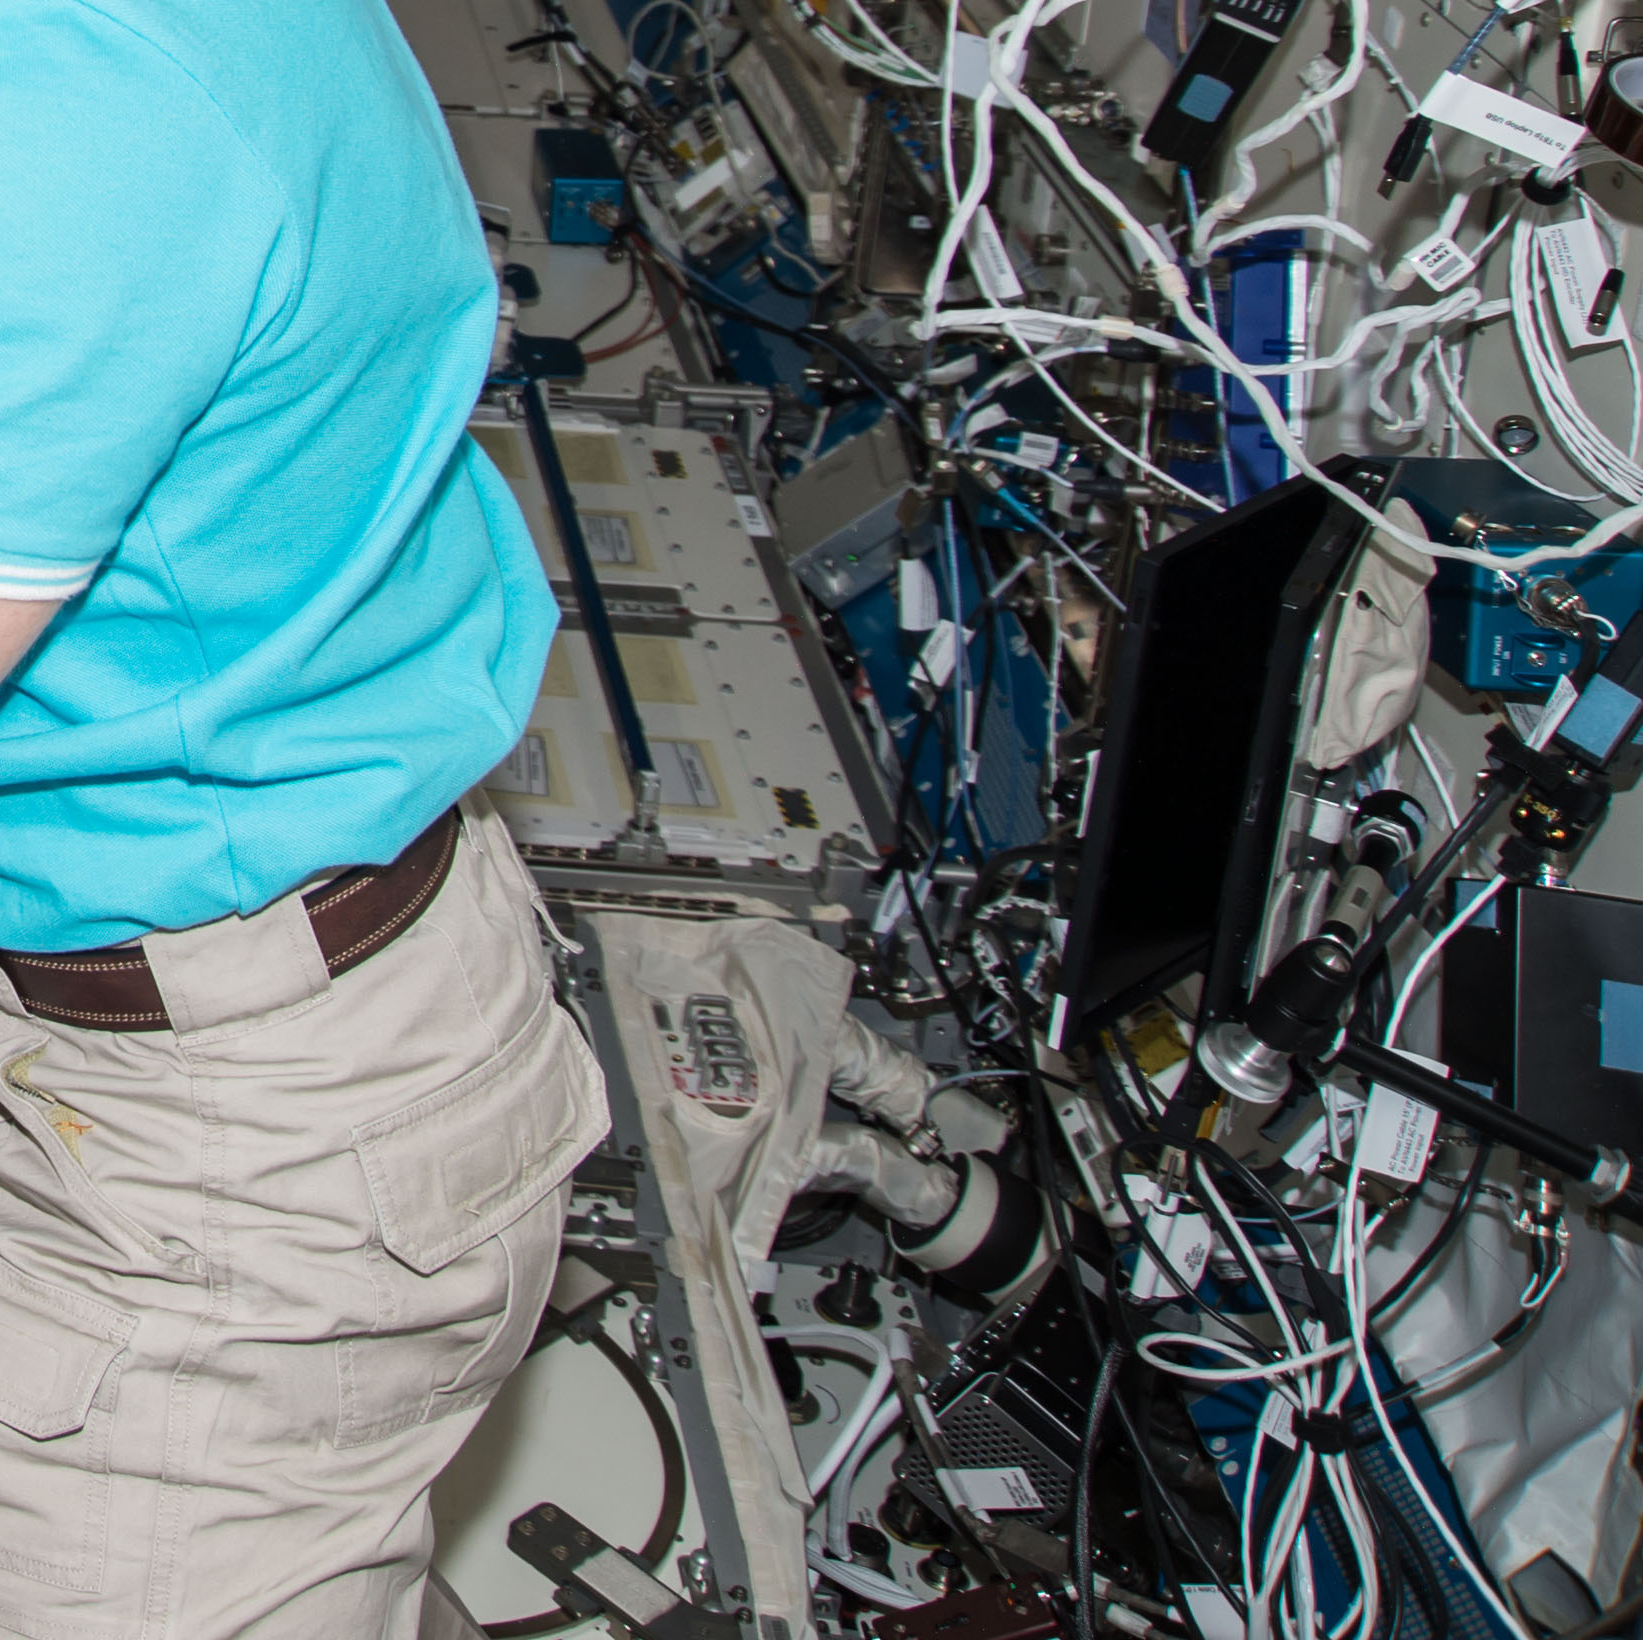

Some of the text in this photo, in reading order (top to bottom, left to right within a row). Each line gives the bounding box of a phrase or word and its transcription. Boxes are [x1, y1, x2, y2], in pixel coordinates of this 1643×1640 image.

[1485, 111, 1504, 125] USB
[1504, 118, 1534, 137] Laptop
[1554, 142, 1566, 151] To
[1425, 248, 1452, 269] CABLE
[1491, 635, 1502, 676] INPUT POWER
[1410, 1106, 1422, 1128] Power
[1396, 1119, 1407, 1139] Cable
[1407, 1128, 1416, 1138] AC
[1390, 1139, 1403, 1161] Power
[1408, 1133, 1425, 1173] Power Input
[1388, 1161, 1397, 1172] AC
[1398, 1165, 1406, 1174] To
